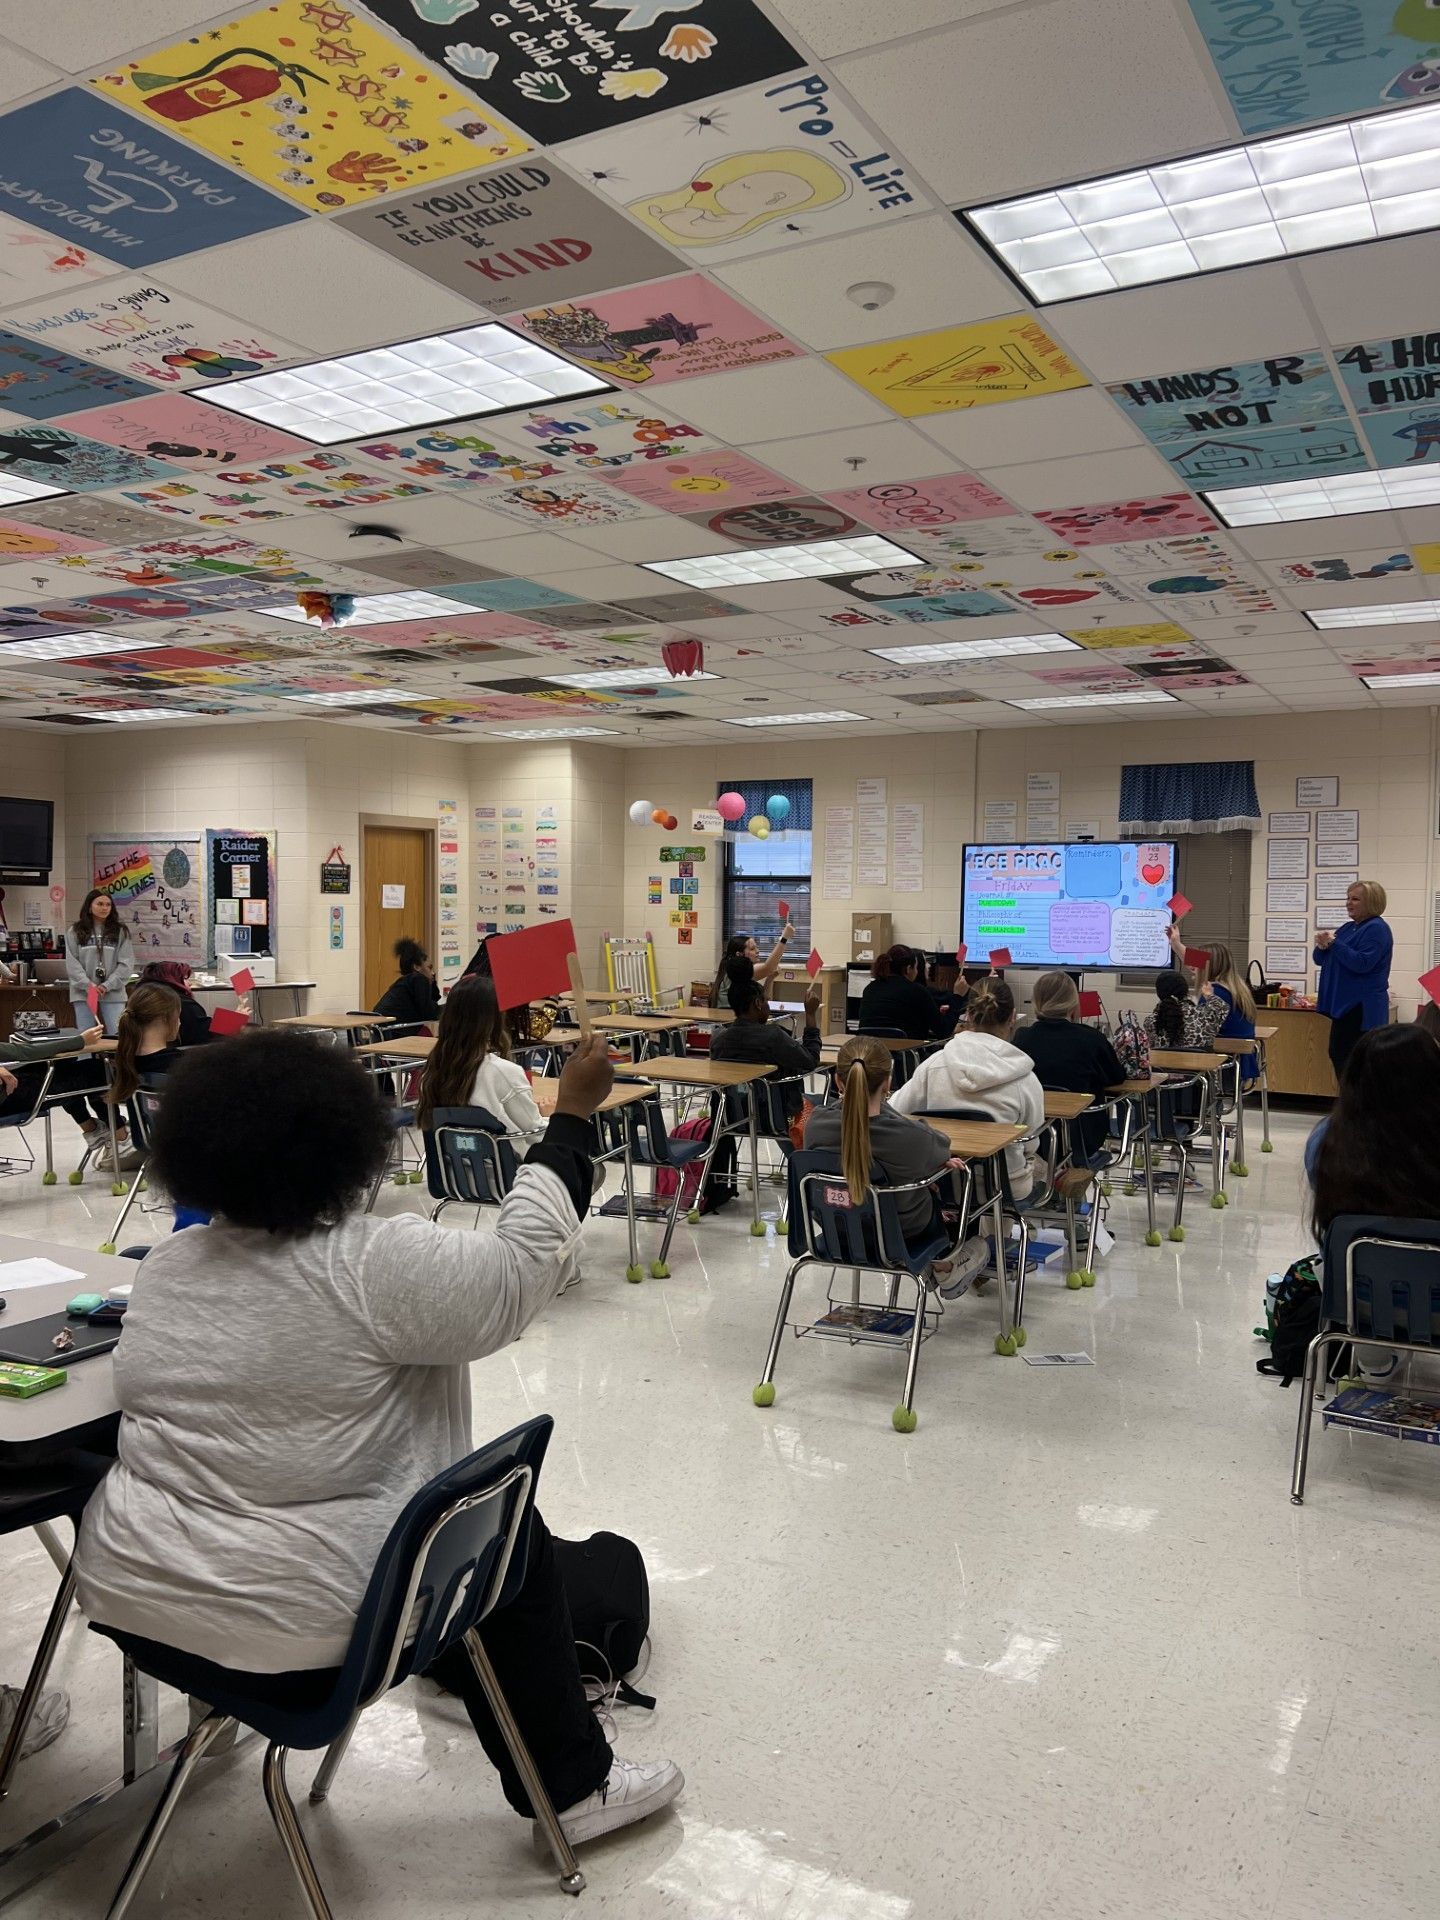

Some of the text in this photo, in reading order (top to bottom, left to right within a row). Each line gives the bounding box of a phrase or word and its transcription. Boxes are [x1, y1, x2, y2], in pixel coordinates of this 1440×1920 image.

[490, 13, 562, 68] a child
[546, 0, 634, 70] shouldn't
[544, 29, 570, 49] to
[567, 52, 598, 75] be
[90, 127, 237, 206] PARKING
[375, 166, 551, 229] IF YOU COULD
[397, 202, 533, 246] BE ANYTHING
[460, 231, 495, 249] BE
[464, 237, 593, 282] KIND
[117, 286, 171, 311] giving
[1122, 367, 1240, 406] HANDS
[1264, 356, 1305, 387] R
[1337, 345, 1380, 373] 4
[1184, 400, 1278, 431] NOT
[220, 840, 260, 852] Raider
[220, 852, 261, 864] Corner
[1067, 849, 1114, 860] Reminders:
[1148, 852, 1159, 861] 23
[98, 851, 140, 881] LET THE
[973, 852, 1062, 871] ECE PRAC
[128, 872, 156, 897] TIMES
[157, 885, 183, 924] ROLL
[830, 1192, 846, 1203] 28
